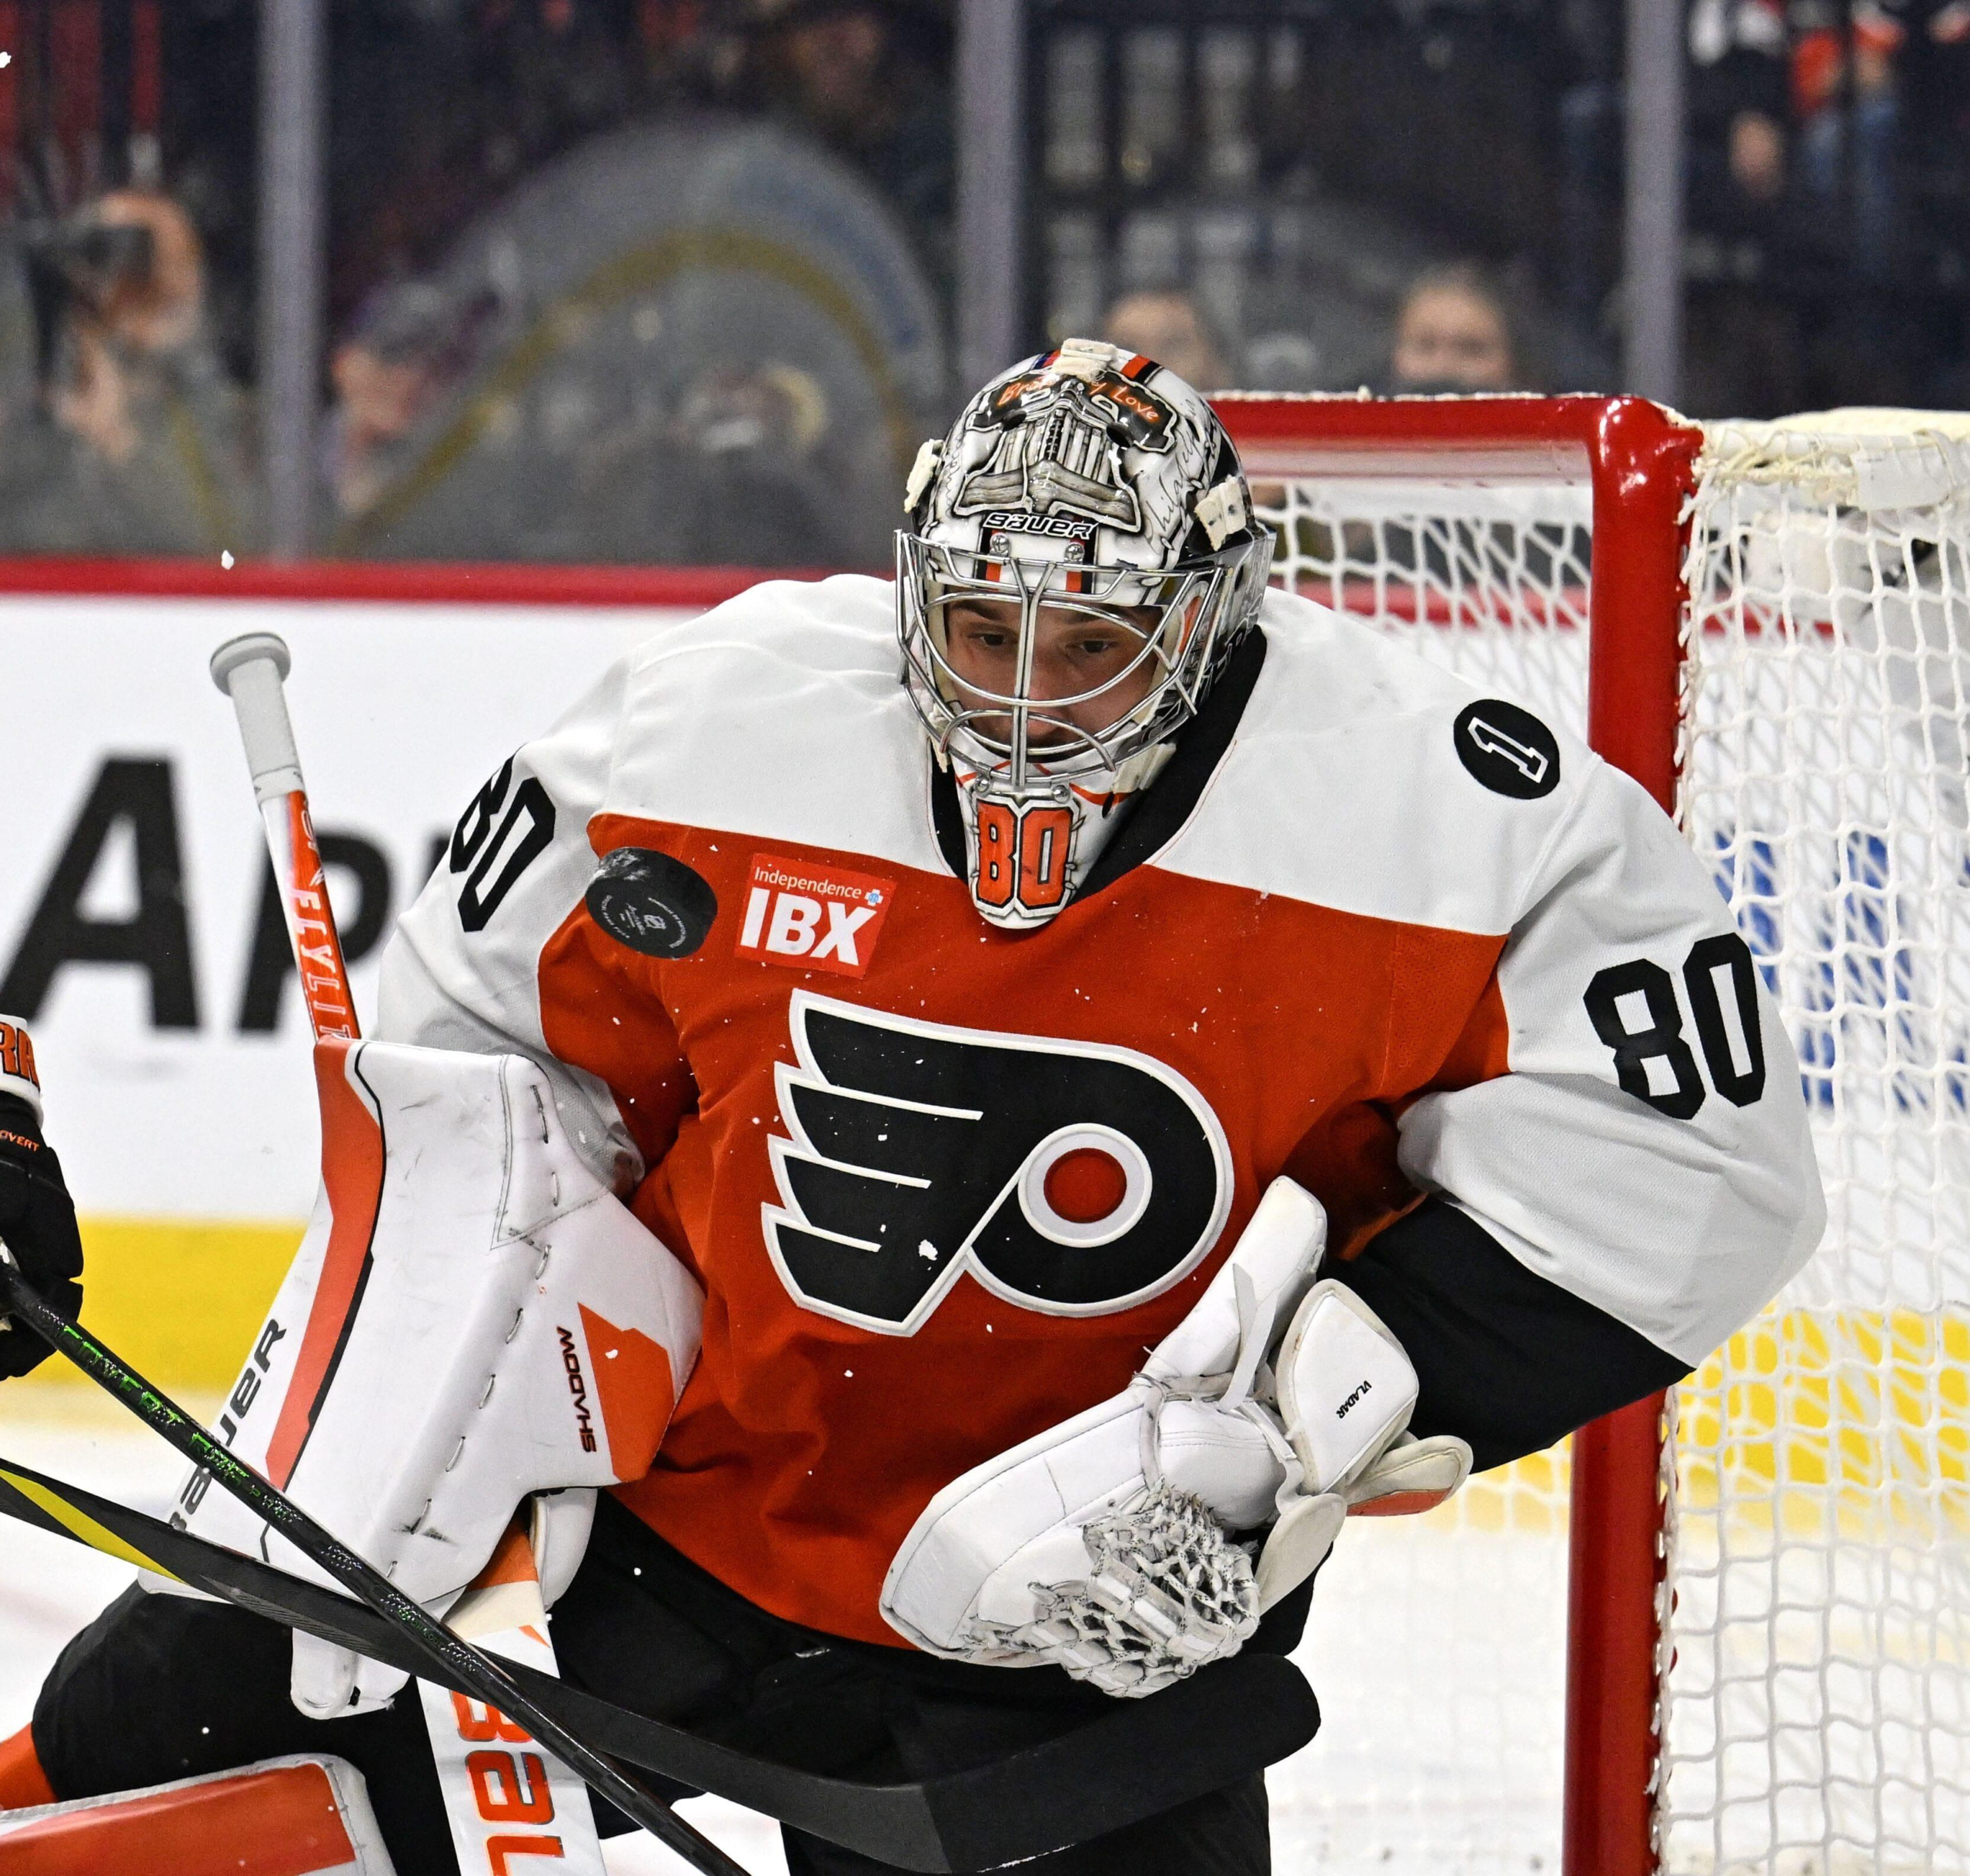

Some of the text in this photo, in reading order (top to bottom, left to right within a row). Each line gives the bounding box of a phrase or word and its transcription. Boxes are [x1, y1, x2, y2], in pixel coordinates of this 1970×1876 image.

[1111, 386, 1158, 421] Love
[983, 512, 1099, 540] BAUER
[1468, 716, 1549, 783] 1
[449, 742, 556, 933] 80
[976, 797, 1074, 910] 80
[753, 866, 863, 900] Independence
[740, 886, 878, 966] IBX
[1583, 931, 1766, 1120] 80
[556, 1325, 597, 1453] SHADOW
[1336, 1380, 1372, 1419] VLADAR
